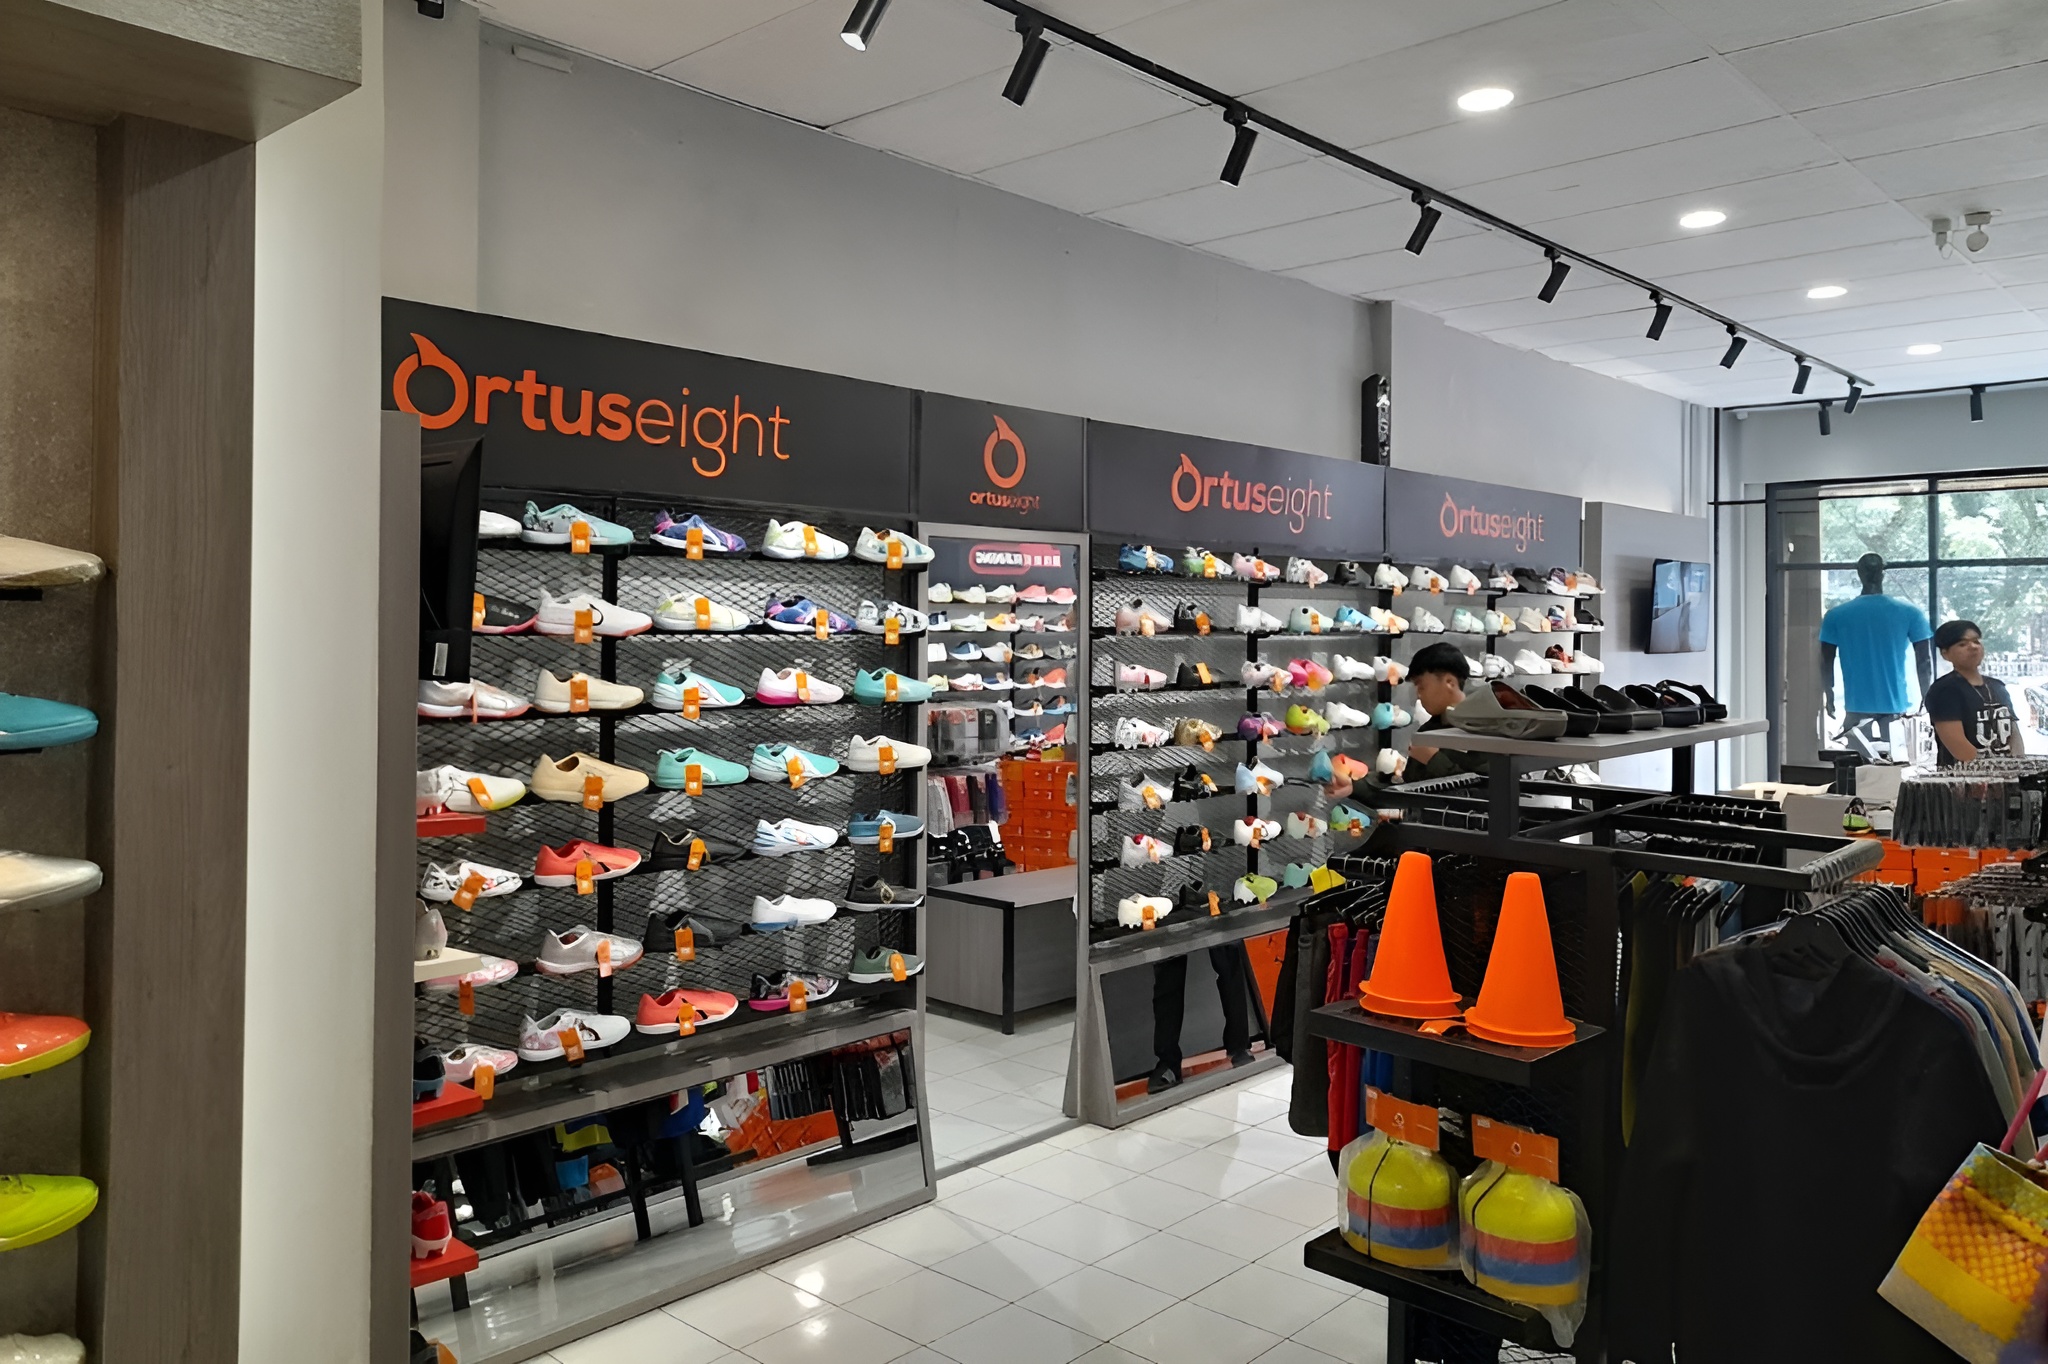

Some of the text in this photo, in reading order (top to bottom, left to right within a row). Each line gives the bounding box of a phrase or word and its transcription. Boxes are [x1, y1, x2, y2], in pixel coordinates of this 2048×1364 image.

[393, 332, 791, 478] Ortuseight
[1171, 453, 1333, 534] Ortuseight
[1440, 491, 1545, 553] Ortuseight
